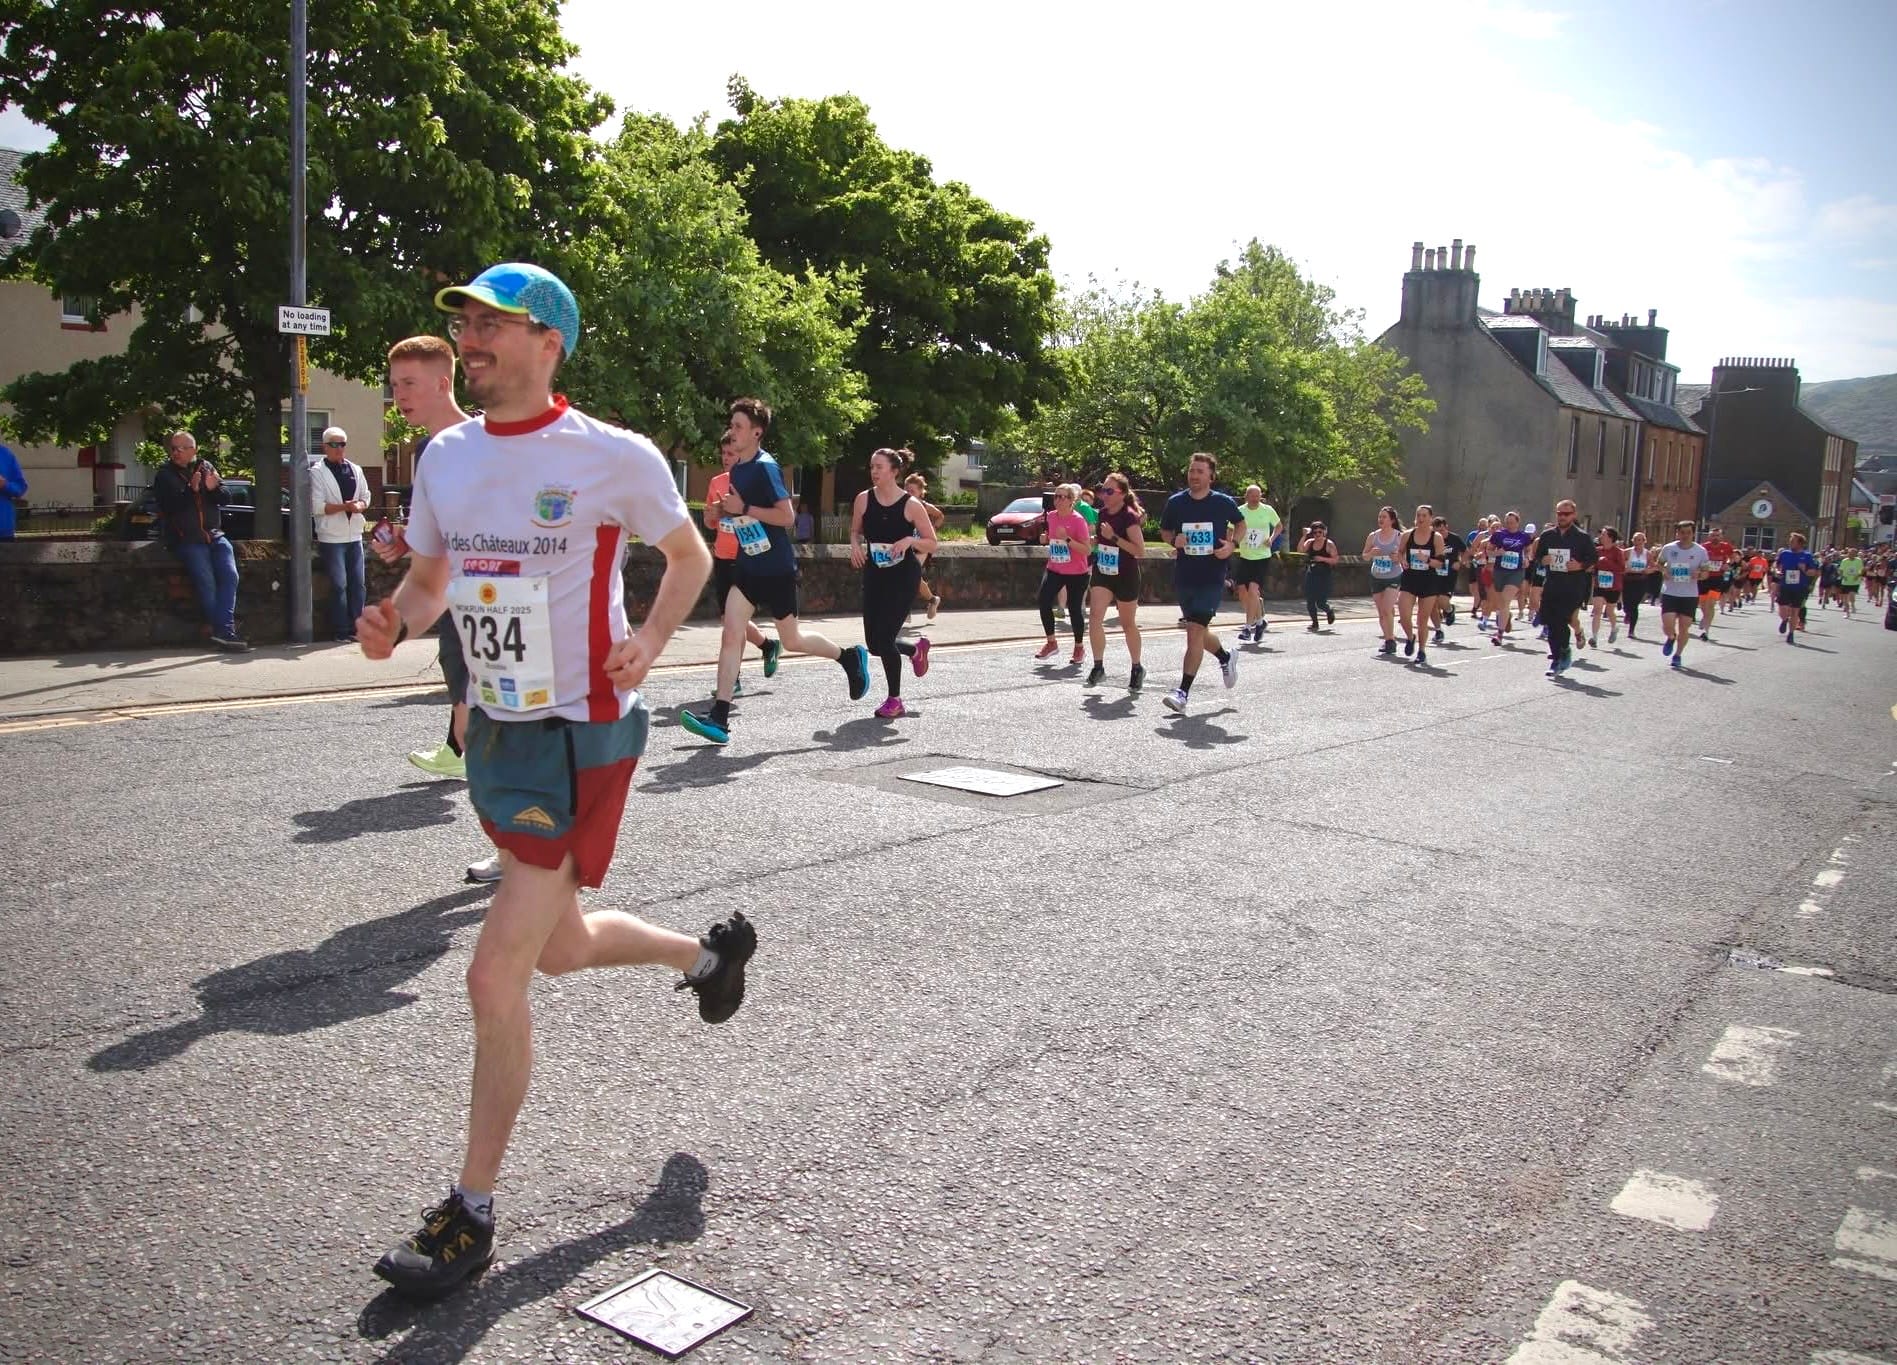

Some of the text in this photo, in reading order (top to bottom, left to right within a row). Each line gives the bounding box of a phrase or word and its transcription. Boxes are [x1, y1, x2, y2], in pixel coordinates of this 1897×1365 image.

[283, 310, 327, 322] No loading
[282, 321, 327, 331] at any time
[1249, 533, 1258, 542] 47
[451, 532, 471, 552] des
[472, 533, 530, 555] Châteaux
[532, 536, 568, 555] 2014
[1554, 553, 1564, 563] 70
[487, 605, 508, 615] HALF
[511, 605, 532, 615] 2025
[462, 613, 527, 663] 234
